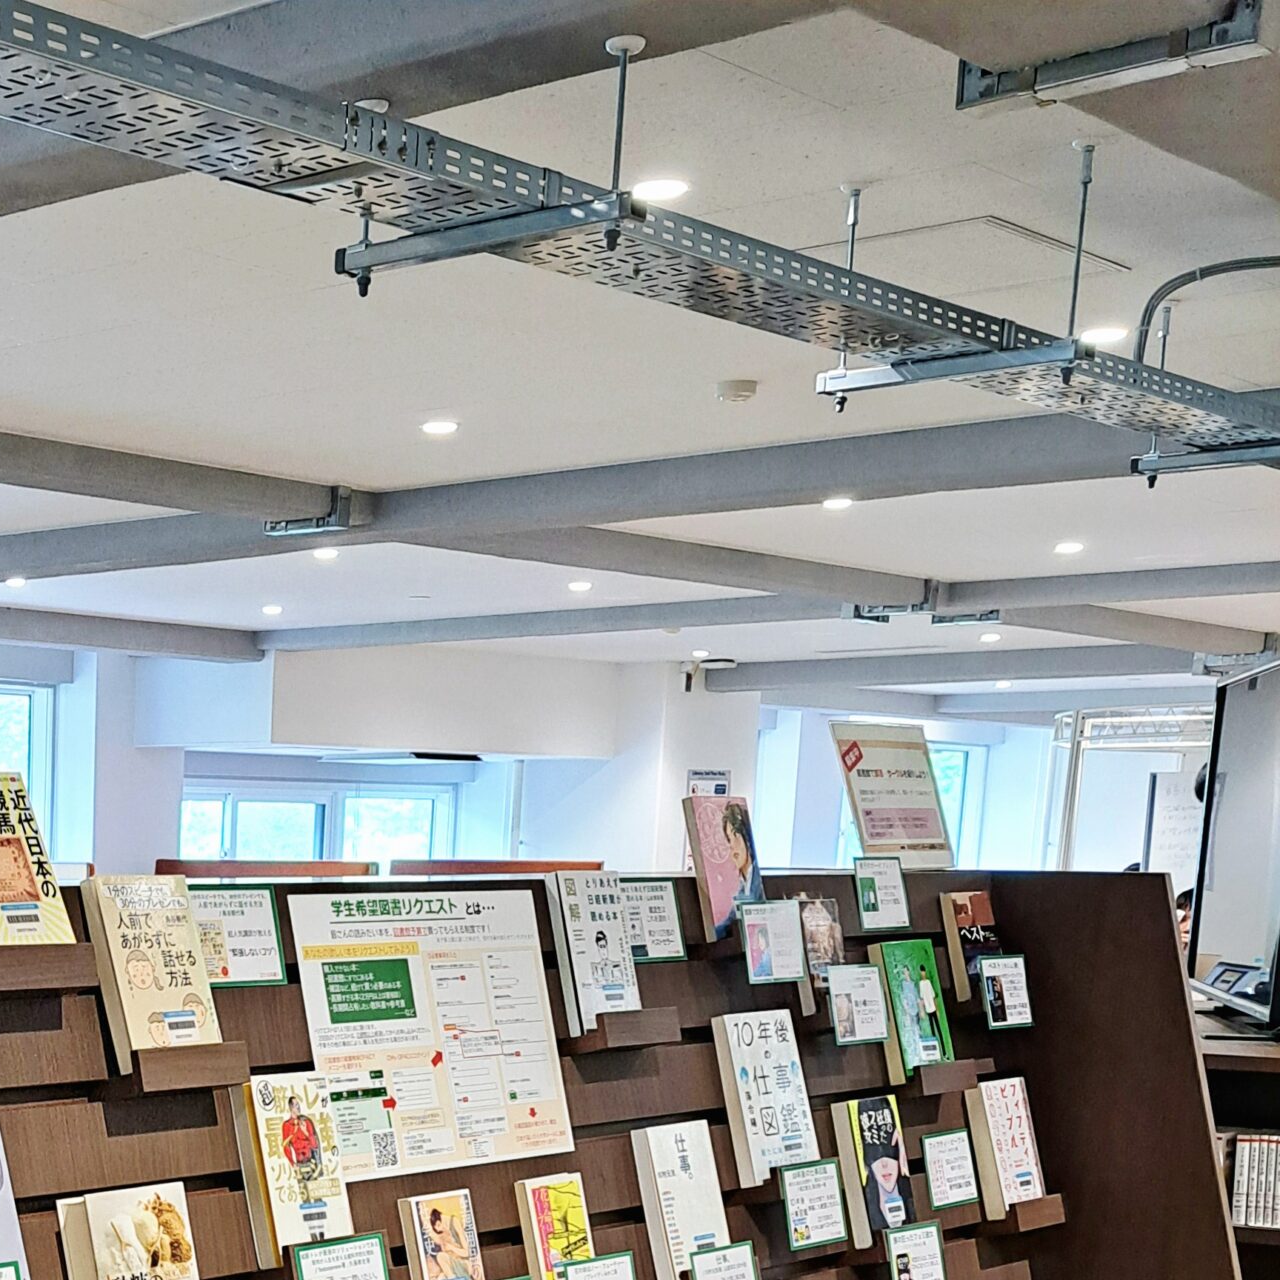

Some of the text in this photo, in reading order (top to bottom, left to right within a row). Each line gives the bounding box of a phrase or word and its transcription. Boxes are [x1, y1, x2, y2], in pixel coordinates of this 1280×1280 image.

[7, 788, 57, 899] 近代日本の
[330, 898, 458, 918] 学生希望図書リクエスト
[590, 911, 619, 922] 読める本
[117, 913, 151, 930] 人前で
[120, 931, 176, 949] あがらずに
[160, 949, 197, 968] 話せる
[166, 970, 193, 988] 方法
[732, 1018, 790, 1048] 10年後
[753, 1063, 792, 1096] 仕事
[760, 1103, 802, 1137] 図鑑
